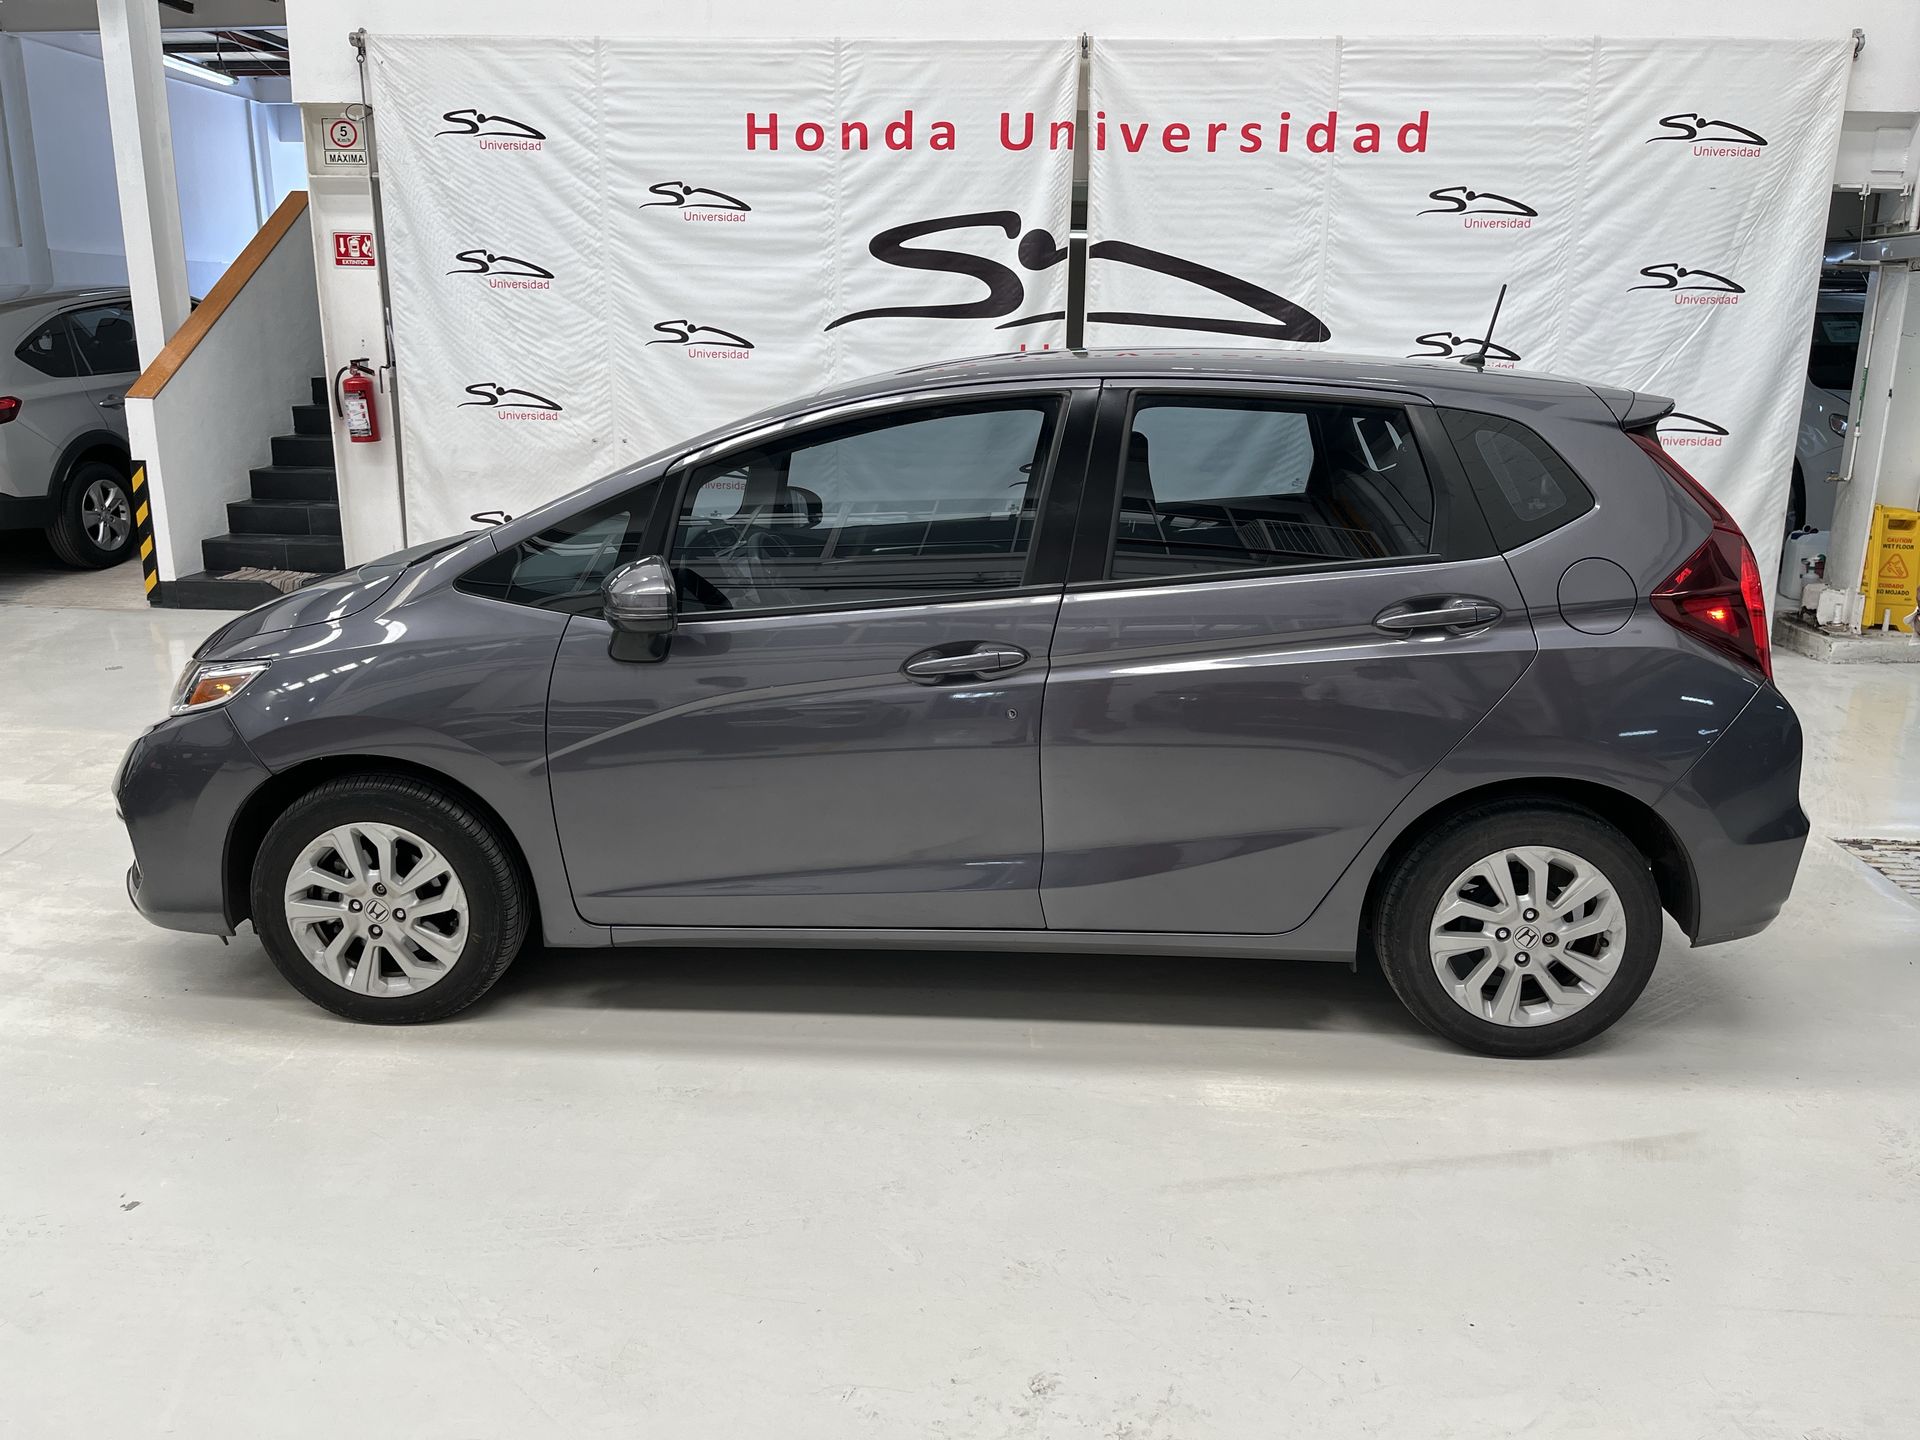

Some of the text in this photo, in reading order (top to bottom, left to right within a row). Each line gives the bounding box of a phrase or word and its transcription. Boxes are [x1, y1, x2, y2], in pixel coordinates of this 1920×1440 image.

[339, 126, 348, 138] 5
[746, 108, 1430, 155] Honda Universidad
[479, 140, 541, 150] Universidad
[1693, 146, 1761, 157] Universidad
[329, 152, 365, 163] MÁXIMA
[684, 212, 746, 222] Universidad
[1464, 218, 1531, 228] Universidad
[489, 279, 550, 289] Universidad
[1674, 294, 1739, 304] Universidad
[688, 349, 749, 359] Universidad
[498, 411, 558, 421] Universidad
